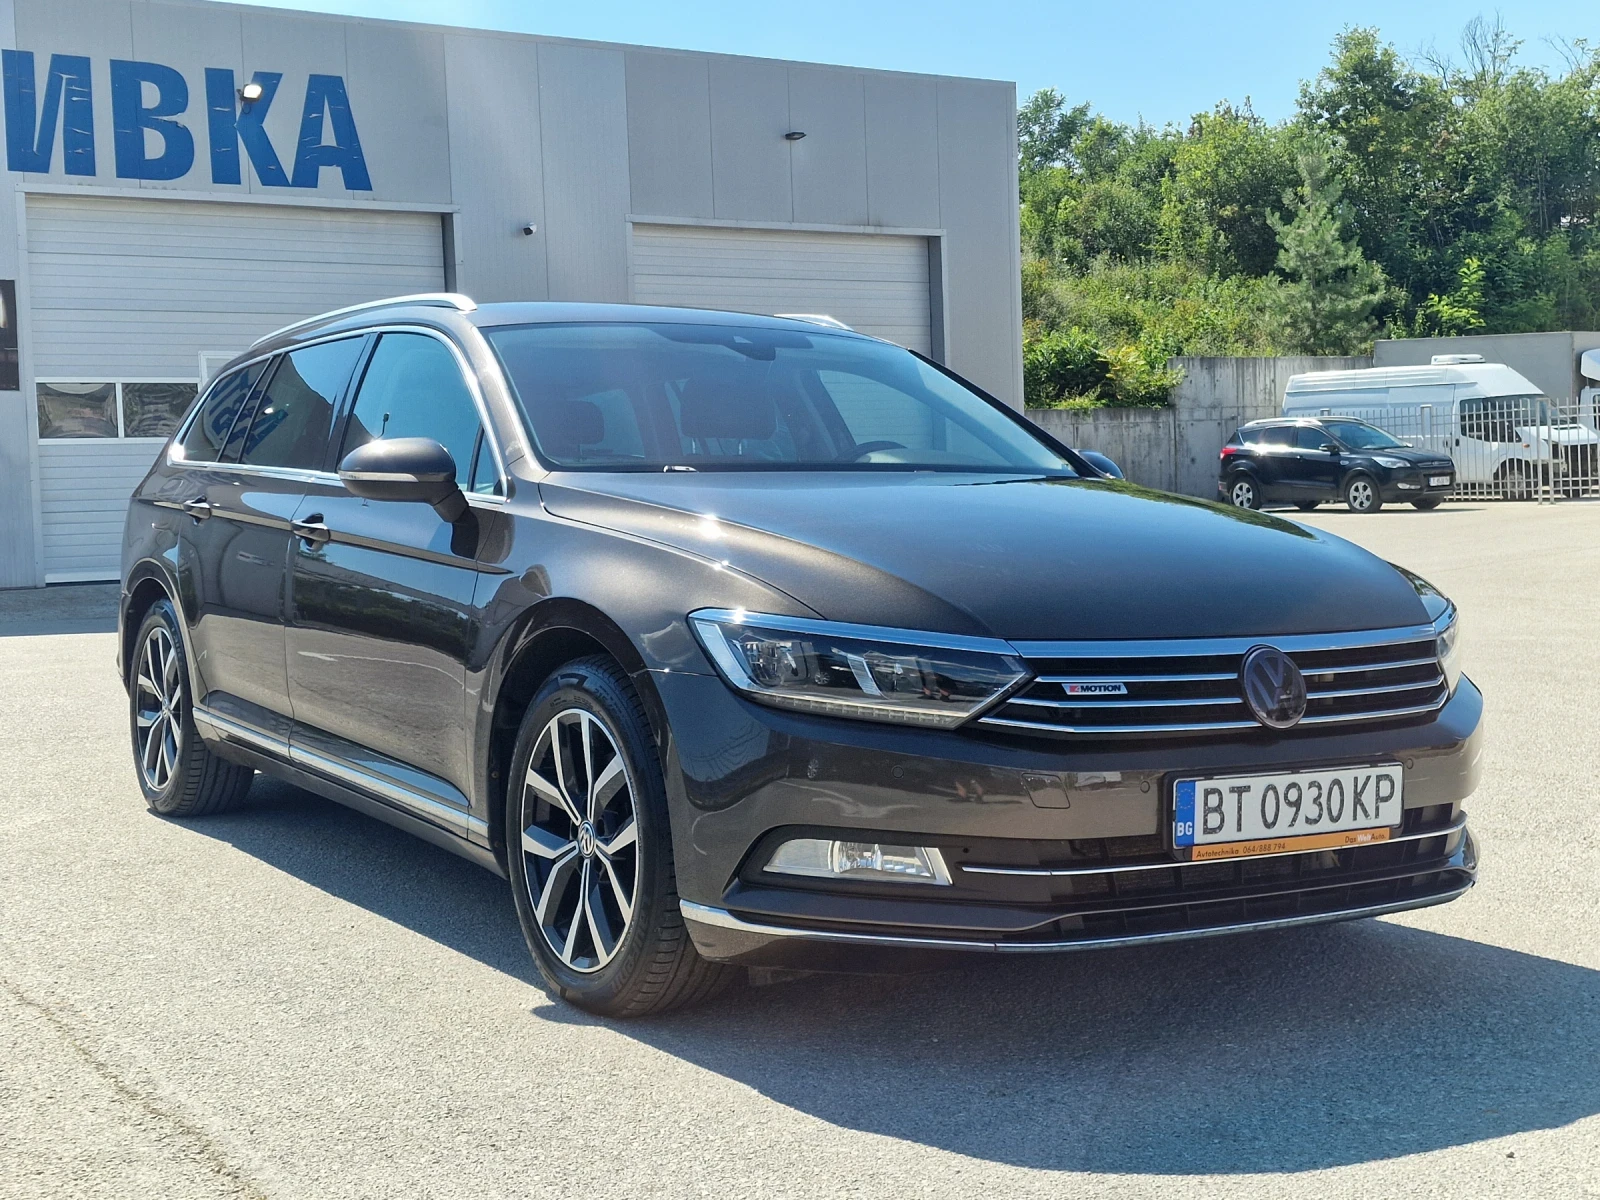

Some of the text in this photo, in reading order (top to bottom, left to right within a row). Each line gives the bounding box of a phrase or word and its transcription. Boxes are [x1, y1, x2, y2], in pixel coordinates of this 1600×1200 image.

[2, 49, 373, 191] ИВКА
[1069, 684, 1121, 693] 4MOTION
[1202, 773, 1395, 835] BT 0930 KP
[1177, 821, 1193, 837] BG
